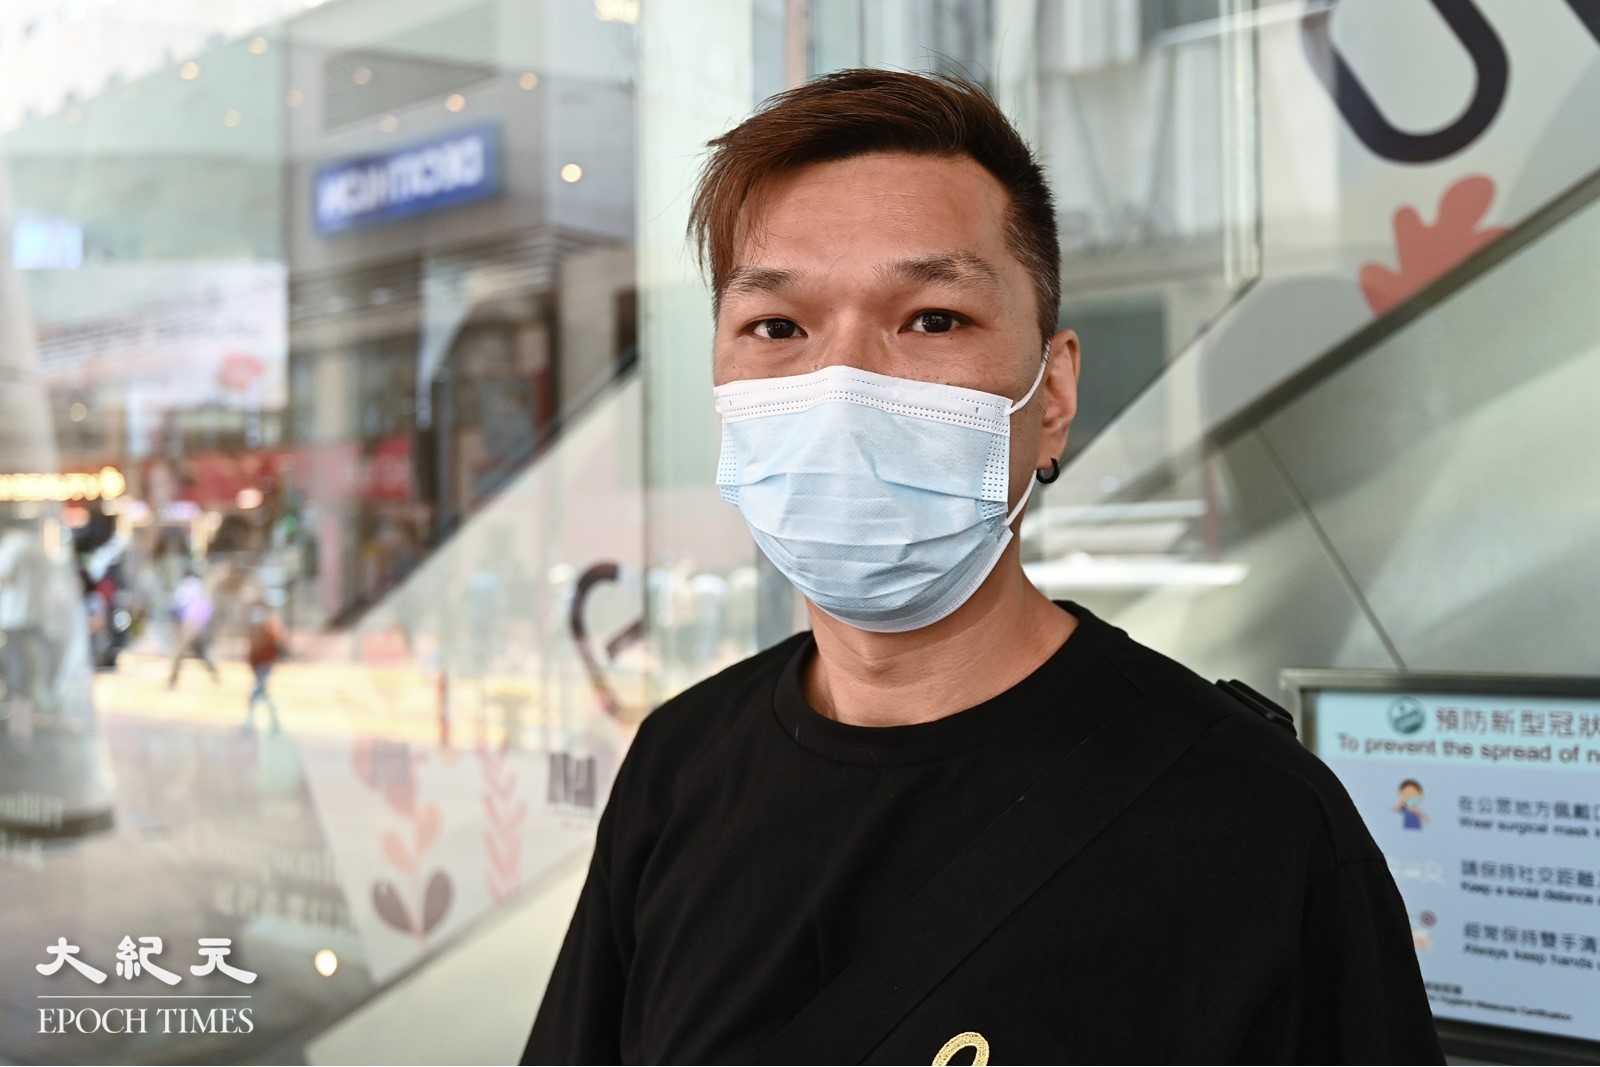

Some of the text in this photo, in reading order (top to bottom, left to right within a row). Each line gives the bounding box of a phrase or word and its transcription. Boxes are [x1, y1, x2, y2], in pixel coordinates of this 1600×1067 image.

[1336, 732, 1359, 752] To
[1364, 736, 1436, 757] prevent
[1442, 738, 1473, 758] the
[1480, 742, 1551, 765] spread
[1558, 744, 1579, 763] of
